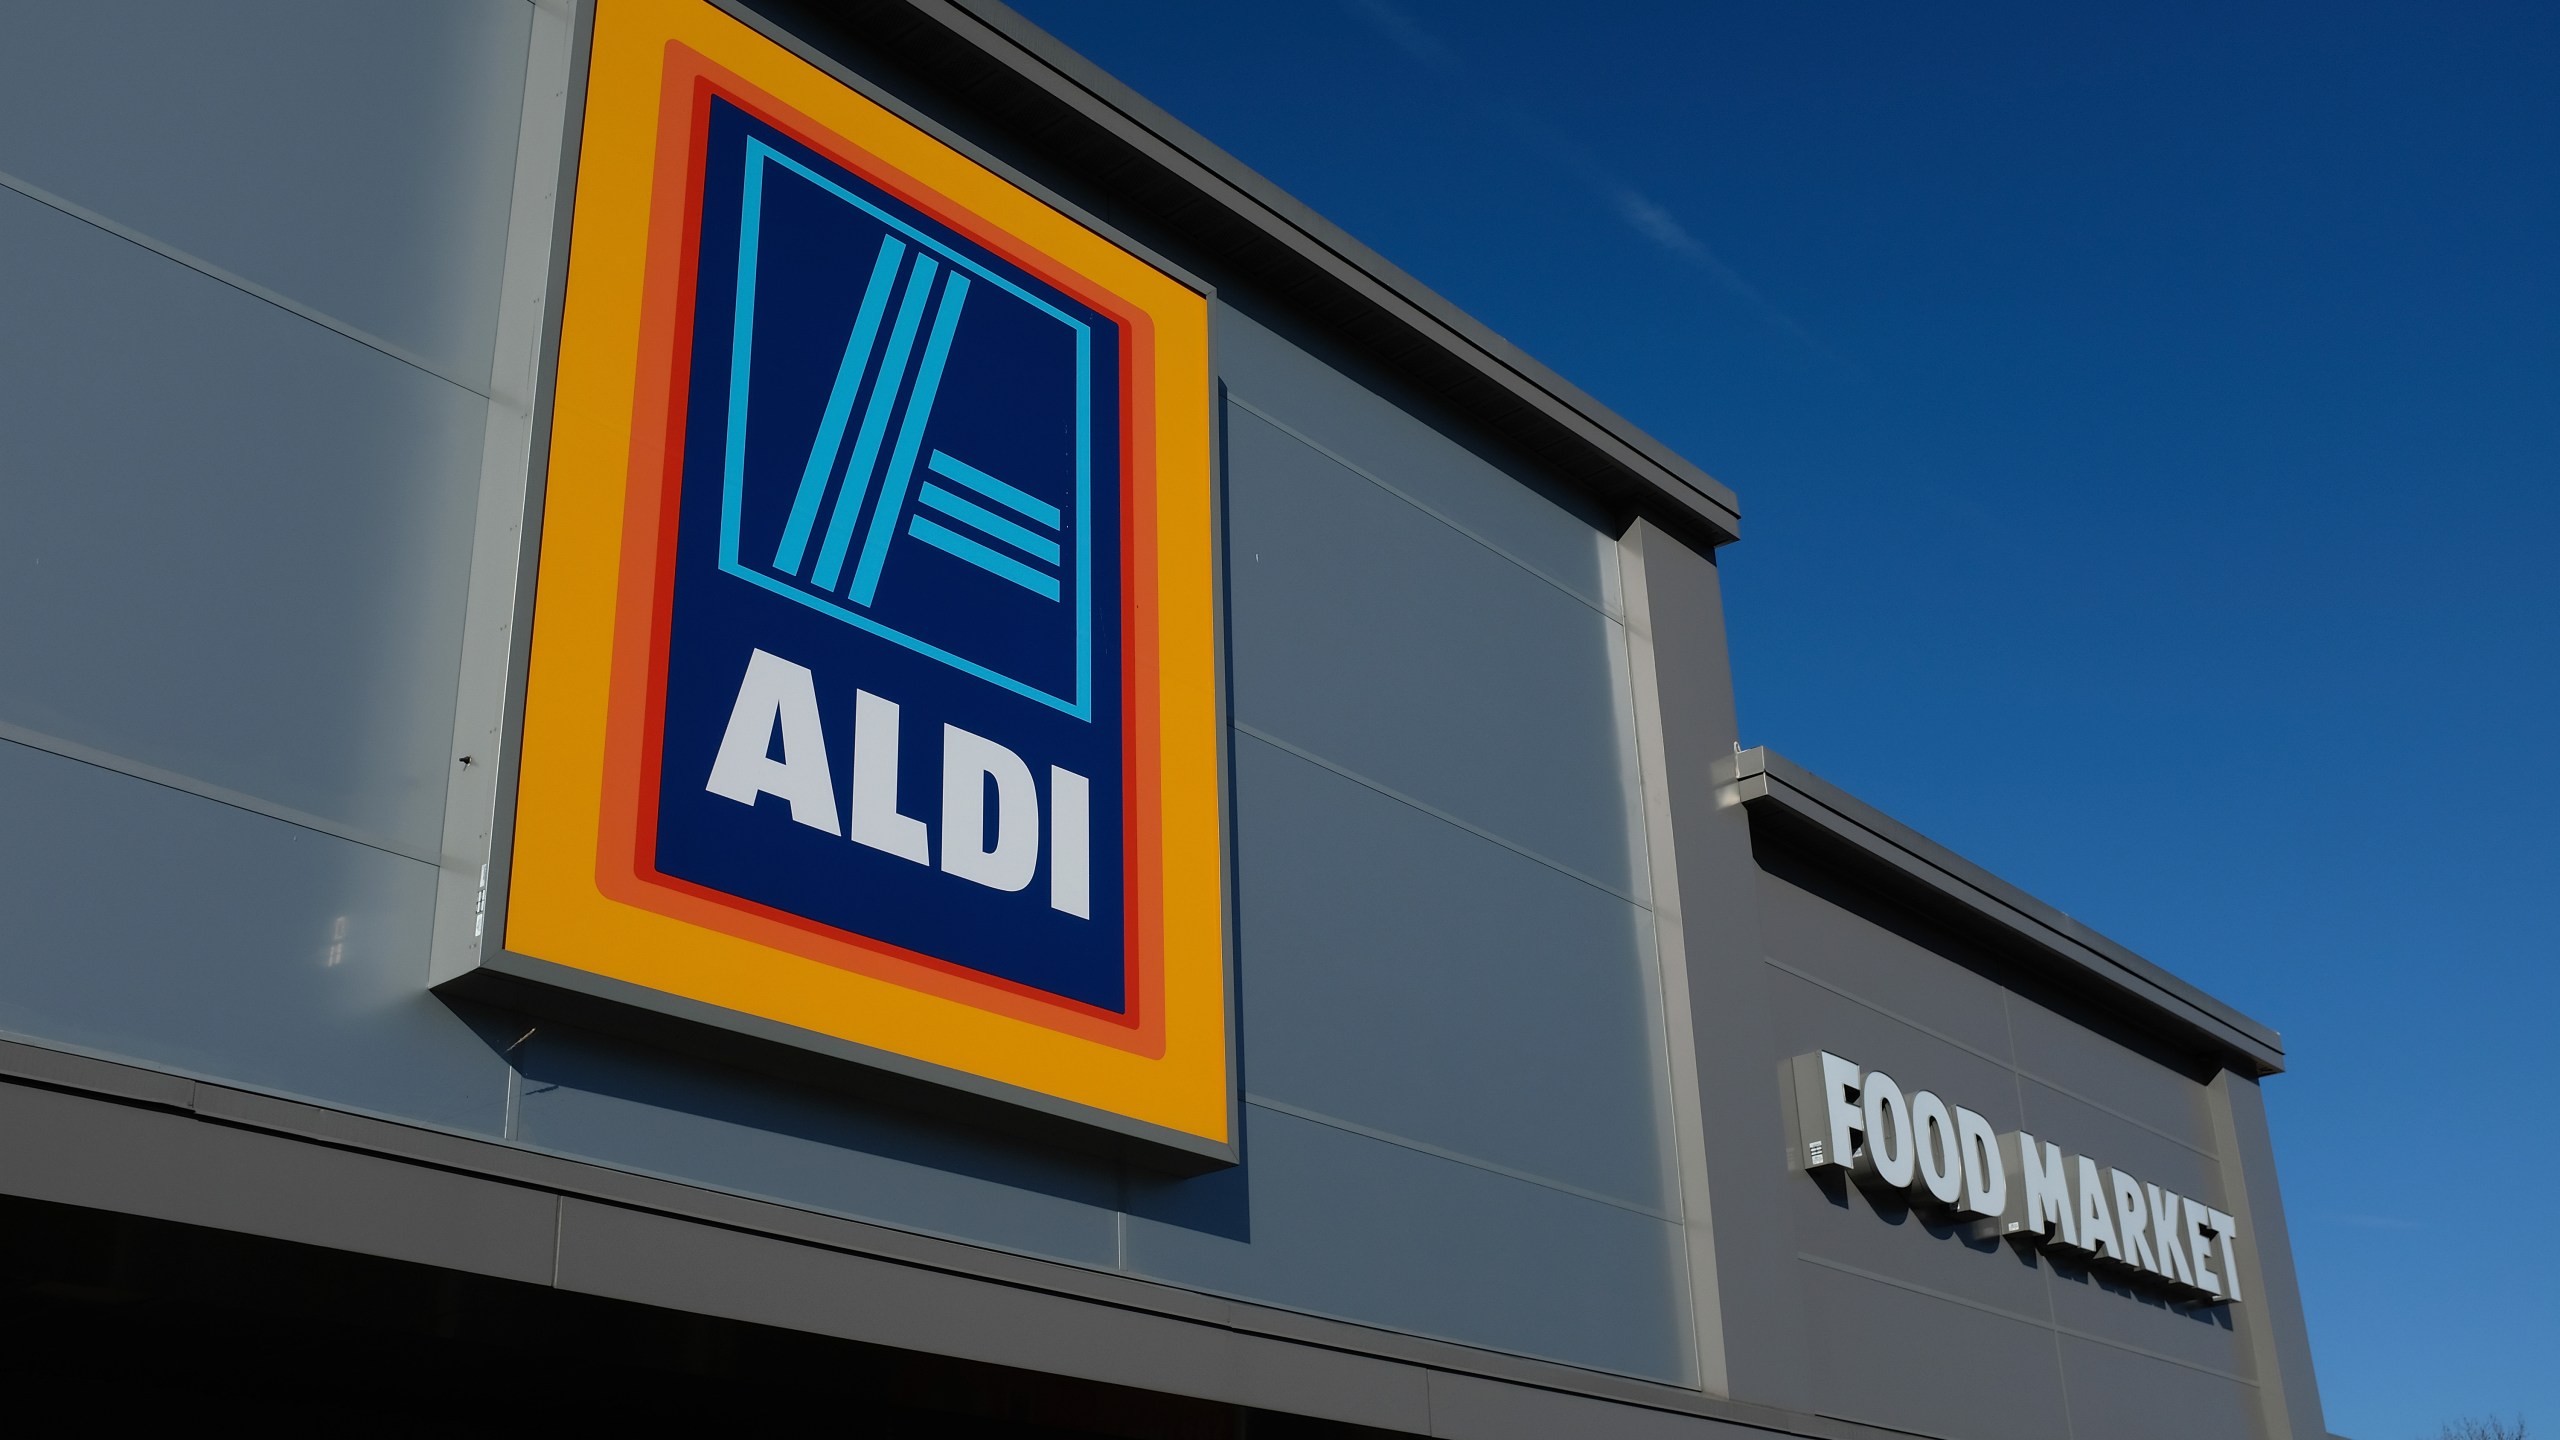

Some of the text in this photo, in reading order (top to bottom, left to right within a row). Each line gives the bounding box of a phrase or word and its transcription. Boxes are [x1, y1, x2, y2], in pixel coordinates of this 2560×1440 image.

[705, 647, 1090, 921] ALDI
[1821, 1050, 2242, 1302] FOOD MARKET
